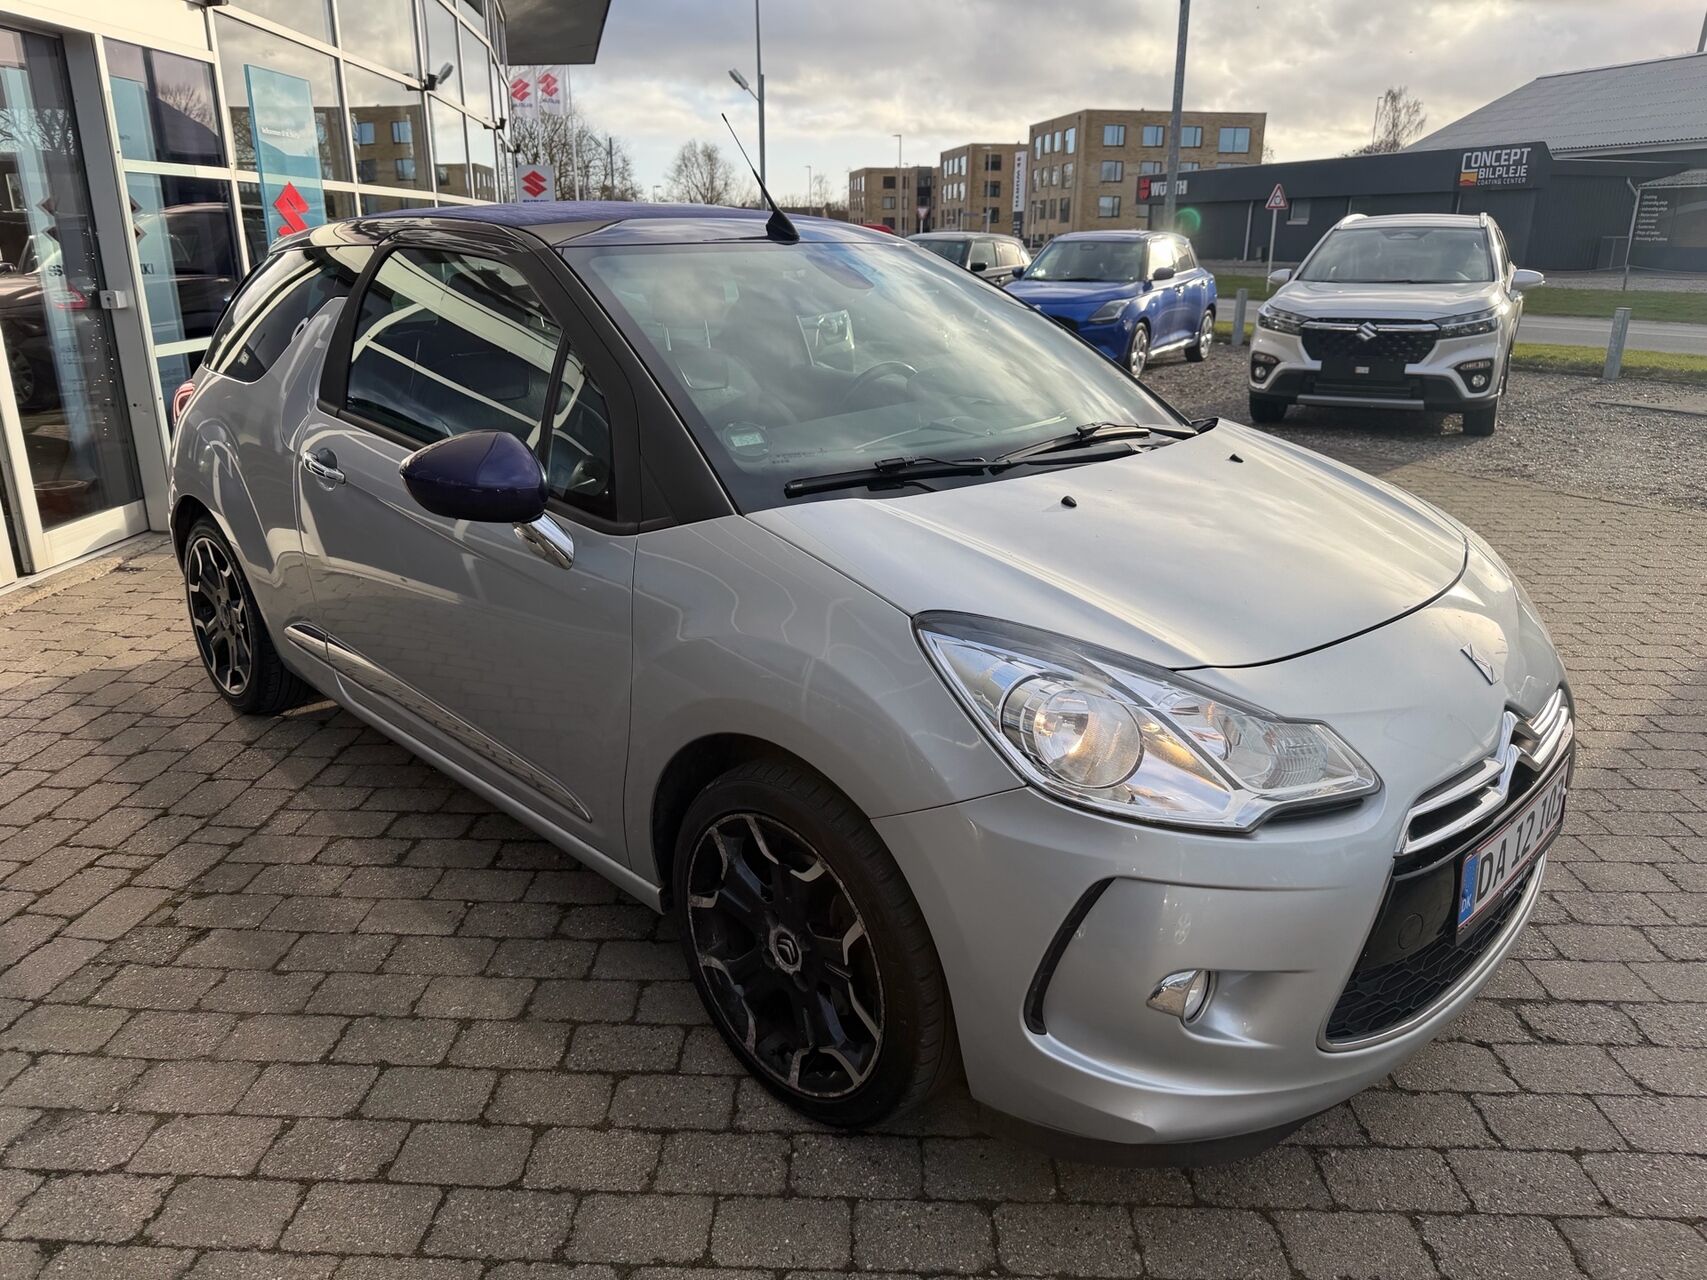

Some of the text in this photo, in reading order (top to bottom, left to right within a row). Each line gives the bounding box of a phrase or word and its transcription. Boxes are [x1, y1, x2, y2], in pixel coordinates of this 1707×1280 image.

[1461, 148, 1531, 172] CONCEPT
[1478, 165, 1528, 179] BILPLEJE
[1151, 180, 1188, 196] WÜTH
[1476, 838, 1507, 903] DA
[1511, 810, 1536, 868] 12
[1536, 775, 1565, 841] 103
[1460, 895, 1472, 913] DK
